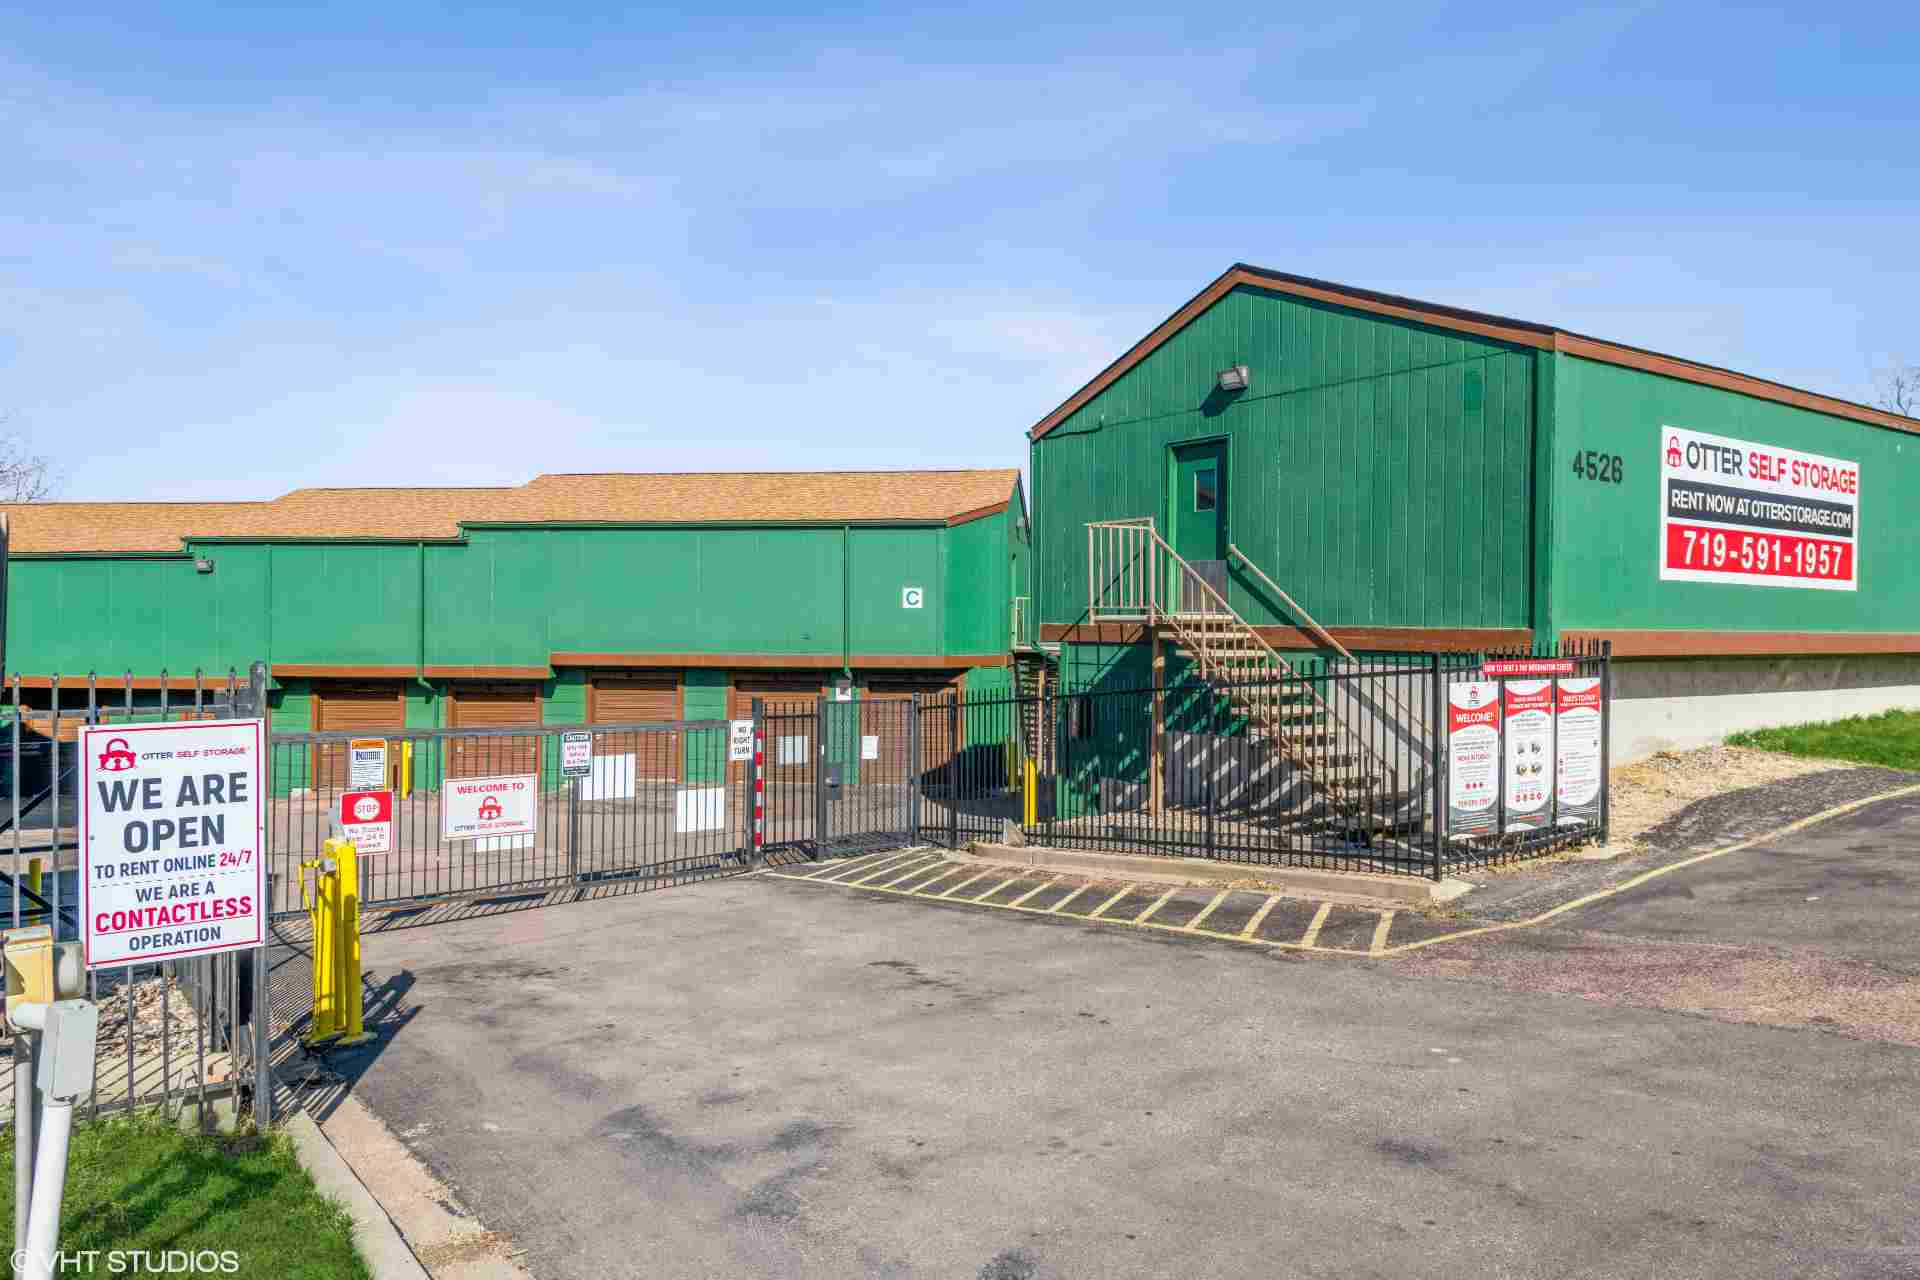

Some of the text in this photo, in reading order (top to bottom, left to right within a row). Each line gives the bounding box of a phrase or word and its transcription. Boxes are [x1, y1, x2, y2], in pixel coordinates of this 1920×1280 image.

[1572, 450, 1623, 484] 4526
[1686, 441, 1857, 494] OTTER SELF STORAGE
[1671, 489, 1852, 529] RENT NOW AT OTTERSTORAGE.COM
[1682, 530, 1842, 576] 719-591-1957
[906, 590, 920, 606] C
[734, 736, 750, 744] RIGHT
[734, 746, 750, 754] TURN
[141, 747, 246, 761] OTTER SELF STORAGE
[97, 771, 248, 813] WE ARE
[457, 782, 525, 795] WELCOME TO
[357, 804, 377, 815] STOP
[123, 814, 224, 853] OPEN
[95, 850, 252, 879] TO RENT ONLINE 24/7
[136, 881, 215, 902] WE ARE A
[95, 896, 252, 932] CONTACTLESS
[129, 926, 221, 951] OPERATION
